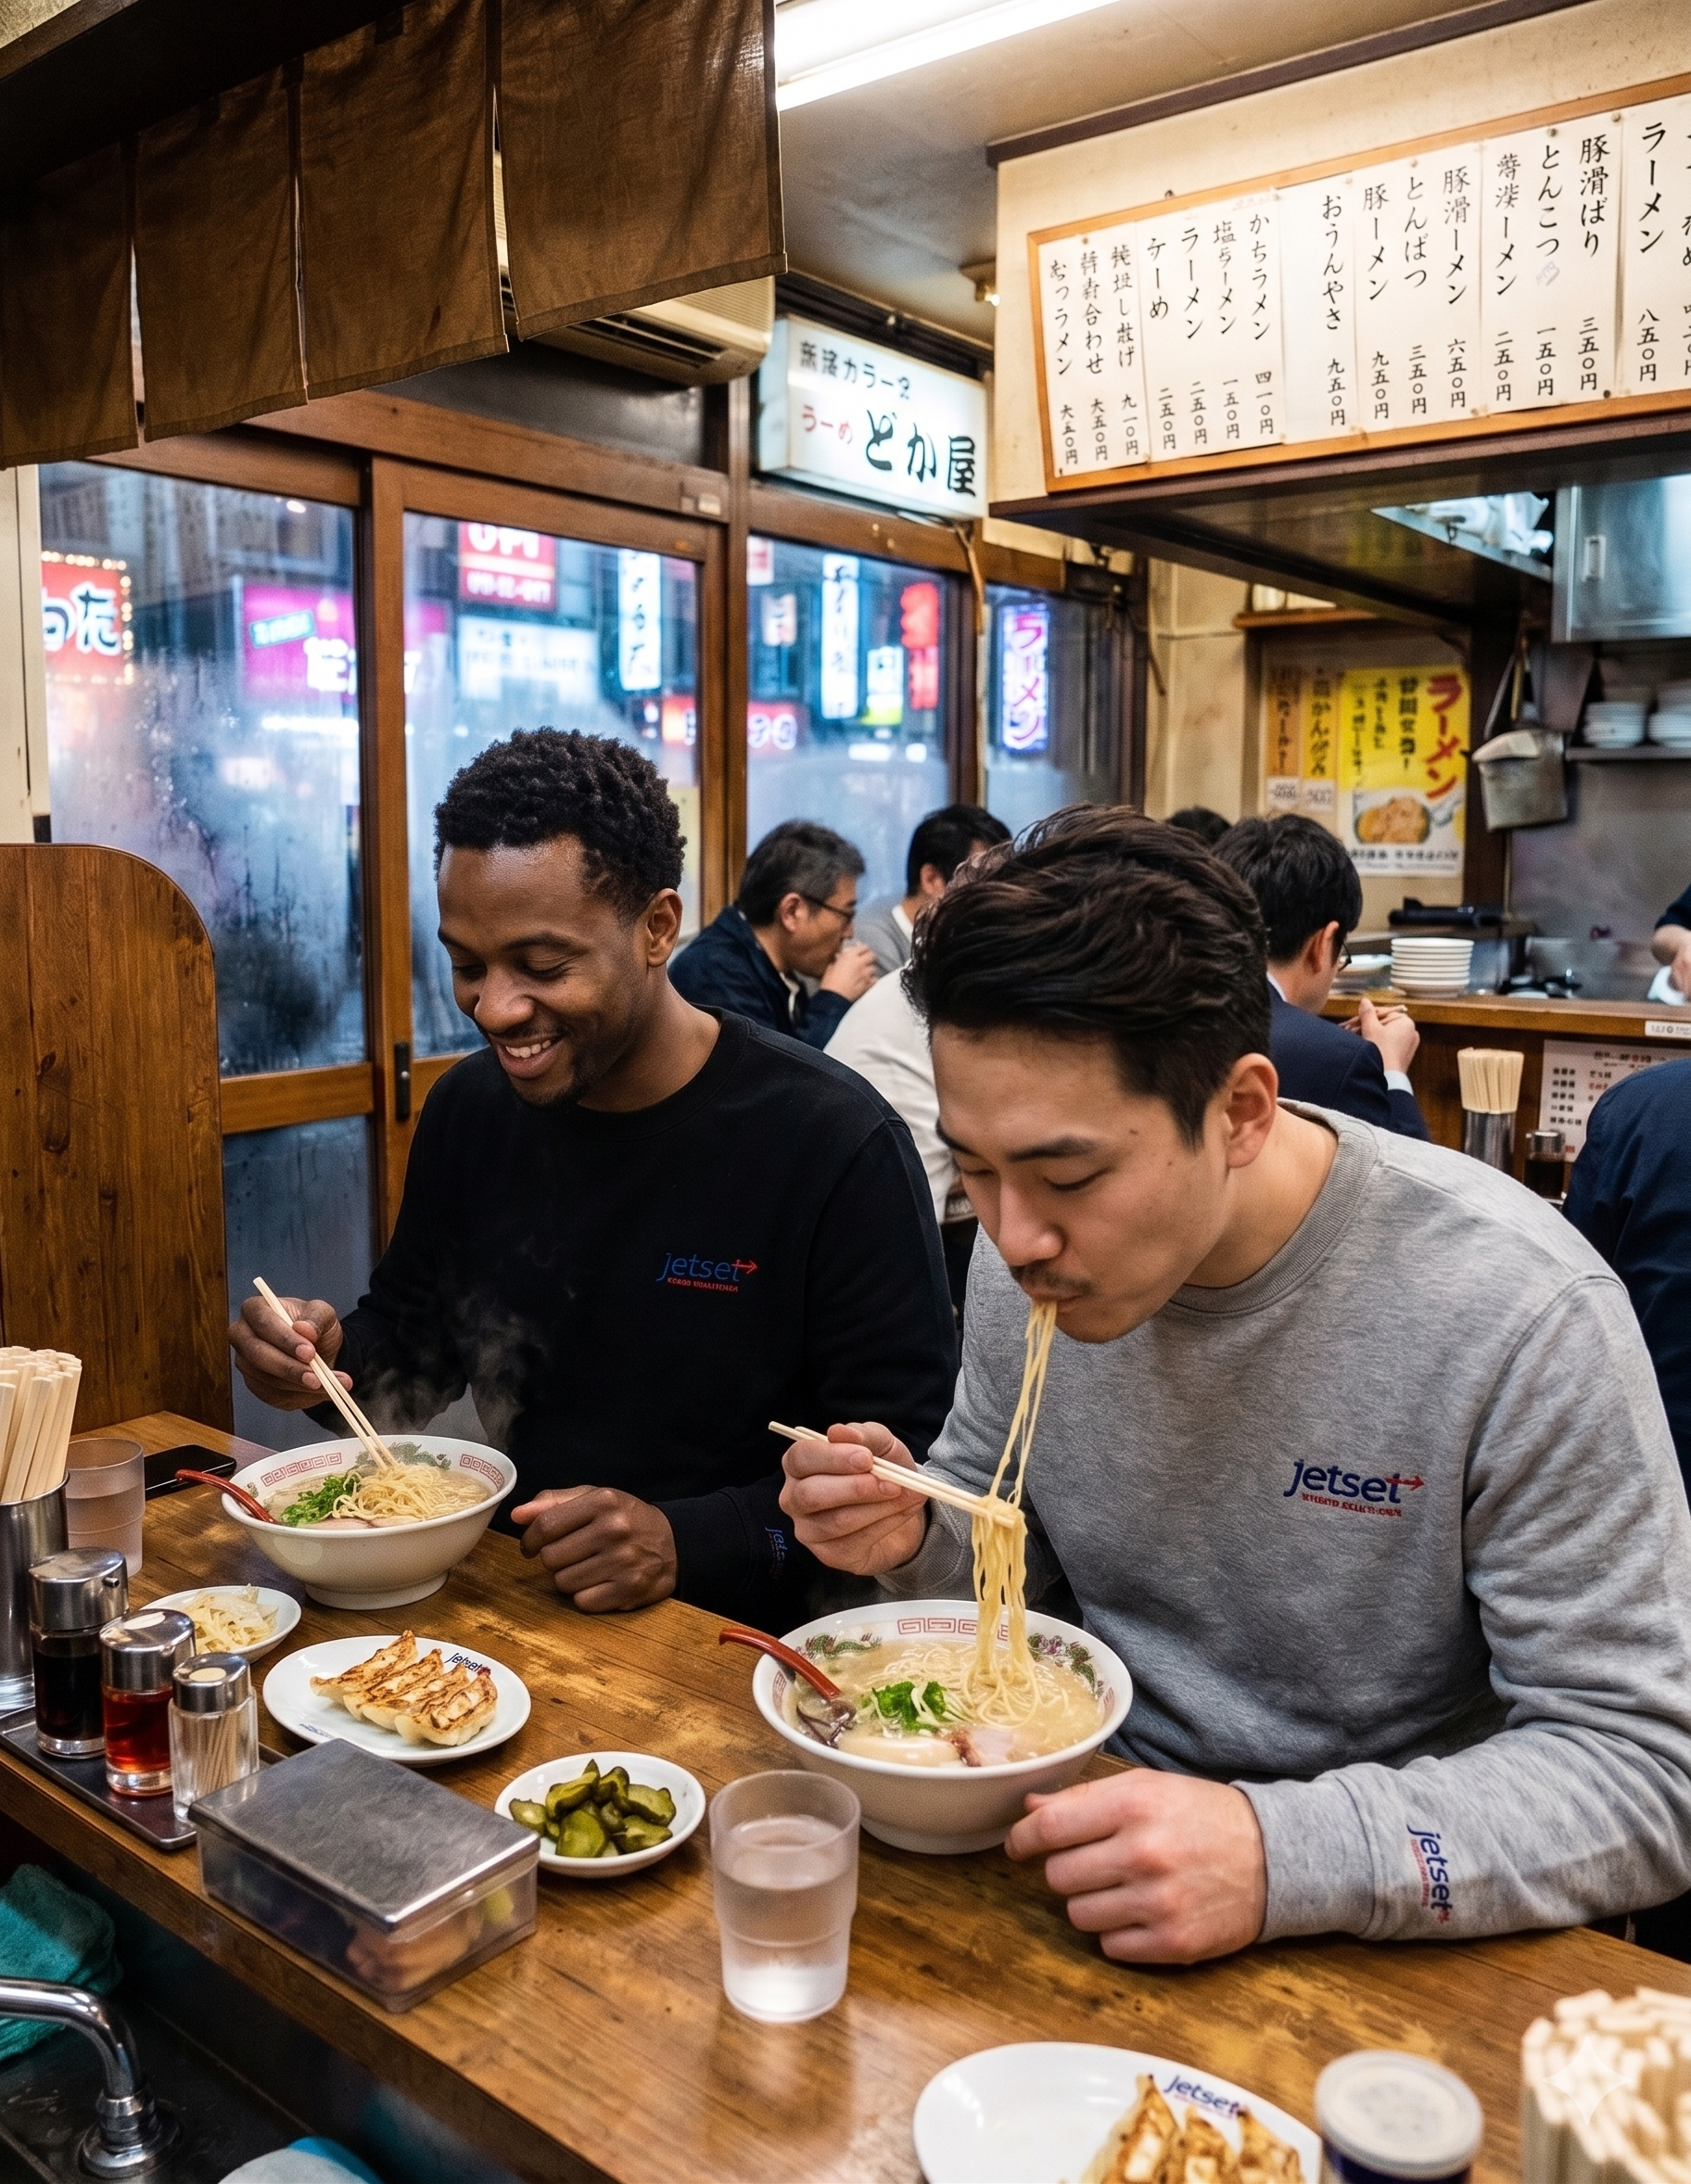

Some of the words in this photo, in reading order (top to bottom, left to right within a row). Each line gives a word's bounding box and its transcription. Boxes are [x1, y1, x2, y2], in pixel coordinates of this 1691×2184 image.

[1535, 145, 1563, 257] とんこつ
[1638, 121, 1666, 253] ラーメン
[1181, 227, 1204, 339] ラーメン
[1249, 213, 1271, 340] かちラメン
[1323, 195, 1344, 330] おうんやさ
[1408, 344, 1428, 414] 三五〇円
[1494, 331, 1515, 401] 二五〇円
[1578, 316, 1599, 391] 三五〇円
[1637, 308, 1660, 382] 八五〇円
[1159, 387, 1176, 450] 二五〇円
[1189, 381, 1207, 444] 二五〇円
[1328, 358, 1345, 425] 九五〇円
[1371, 350, 1390, 419] 九五〇円
[1426, 672, 1463, 801] ラーメン
[1282, 1458, 1402, 1504] jetset
[1405, 1822, 1454, 1911] jetset
